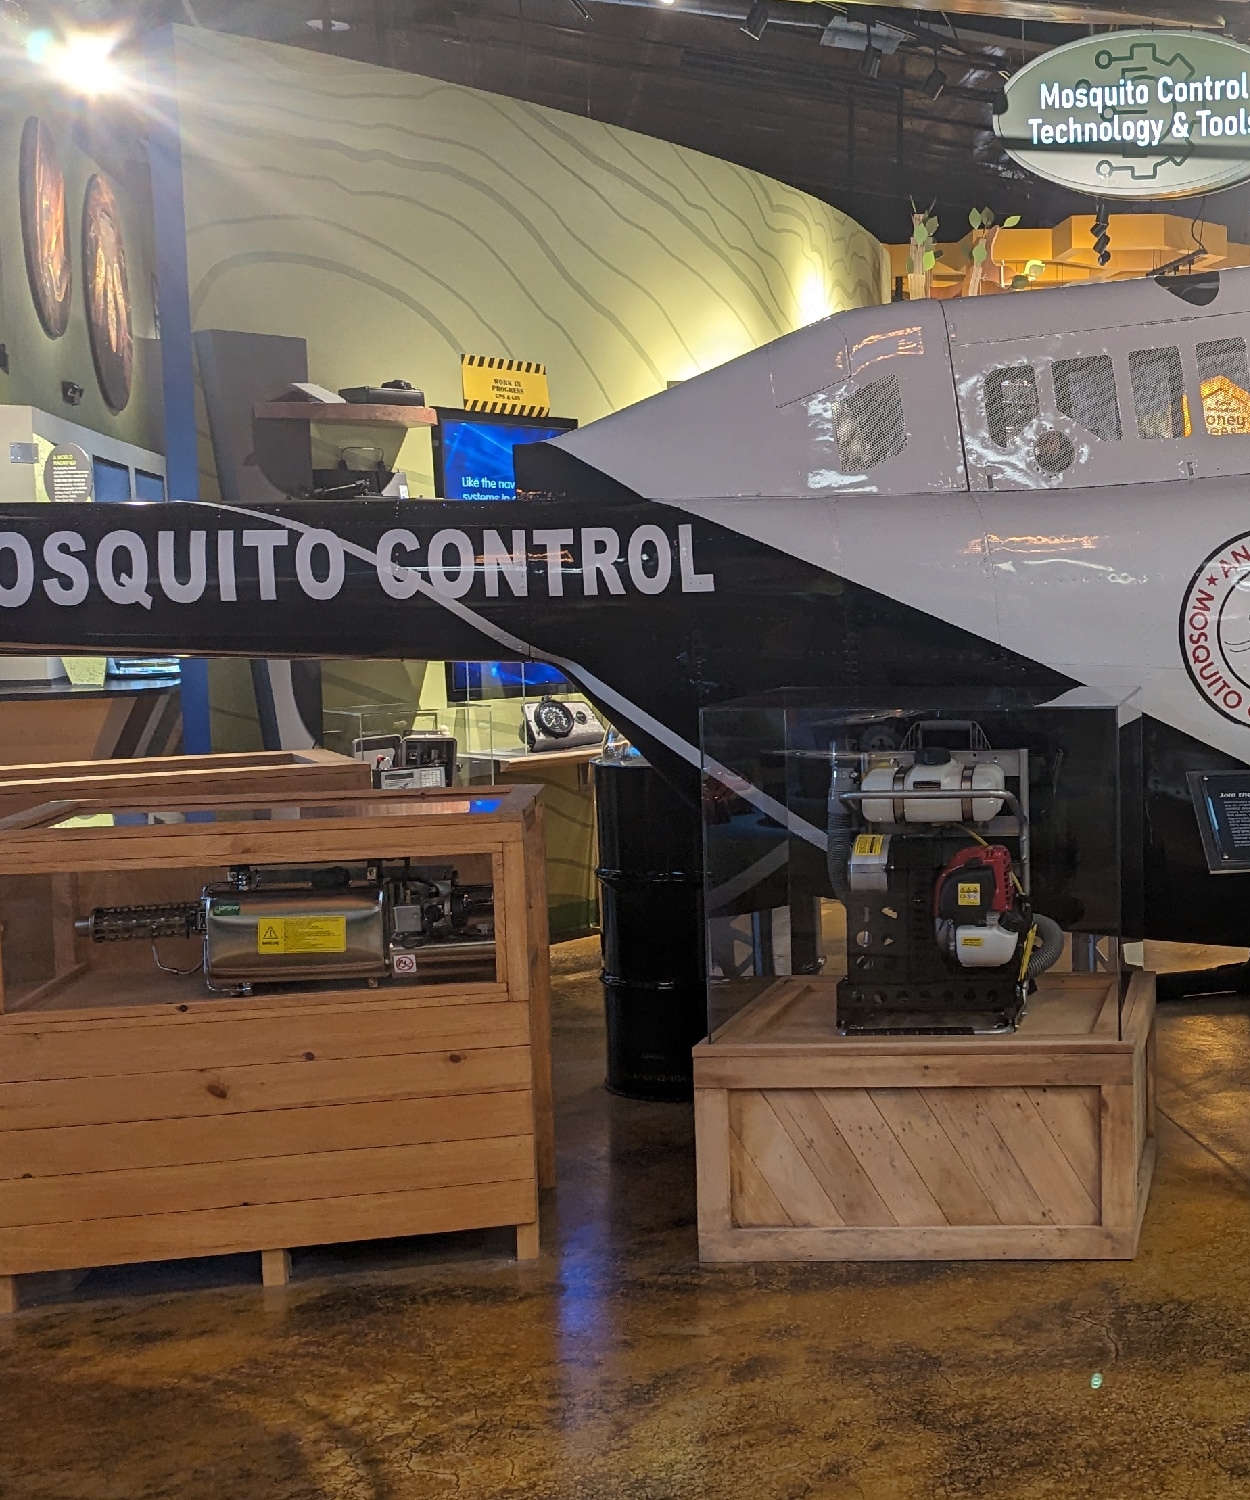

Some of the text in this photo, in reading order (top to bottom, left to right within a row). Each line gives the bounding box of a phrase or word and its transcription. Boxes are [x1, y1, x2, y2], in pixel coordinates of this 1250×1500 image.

[1040, 72, 1249, 114] Mosquito Control
[1028, 115, 1164, 146] Technology
[1172, 111, 1190, 138] &
[491, 385, 525, 394] PROGRESS
[461, 476, 516, 489] Like the nav
[376, 524, 716, 599] CONTROL
[1189, 589, 1243, 710] MOSQUITO
